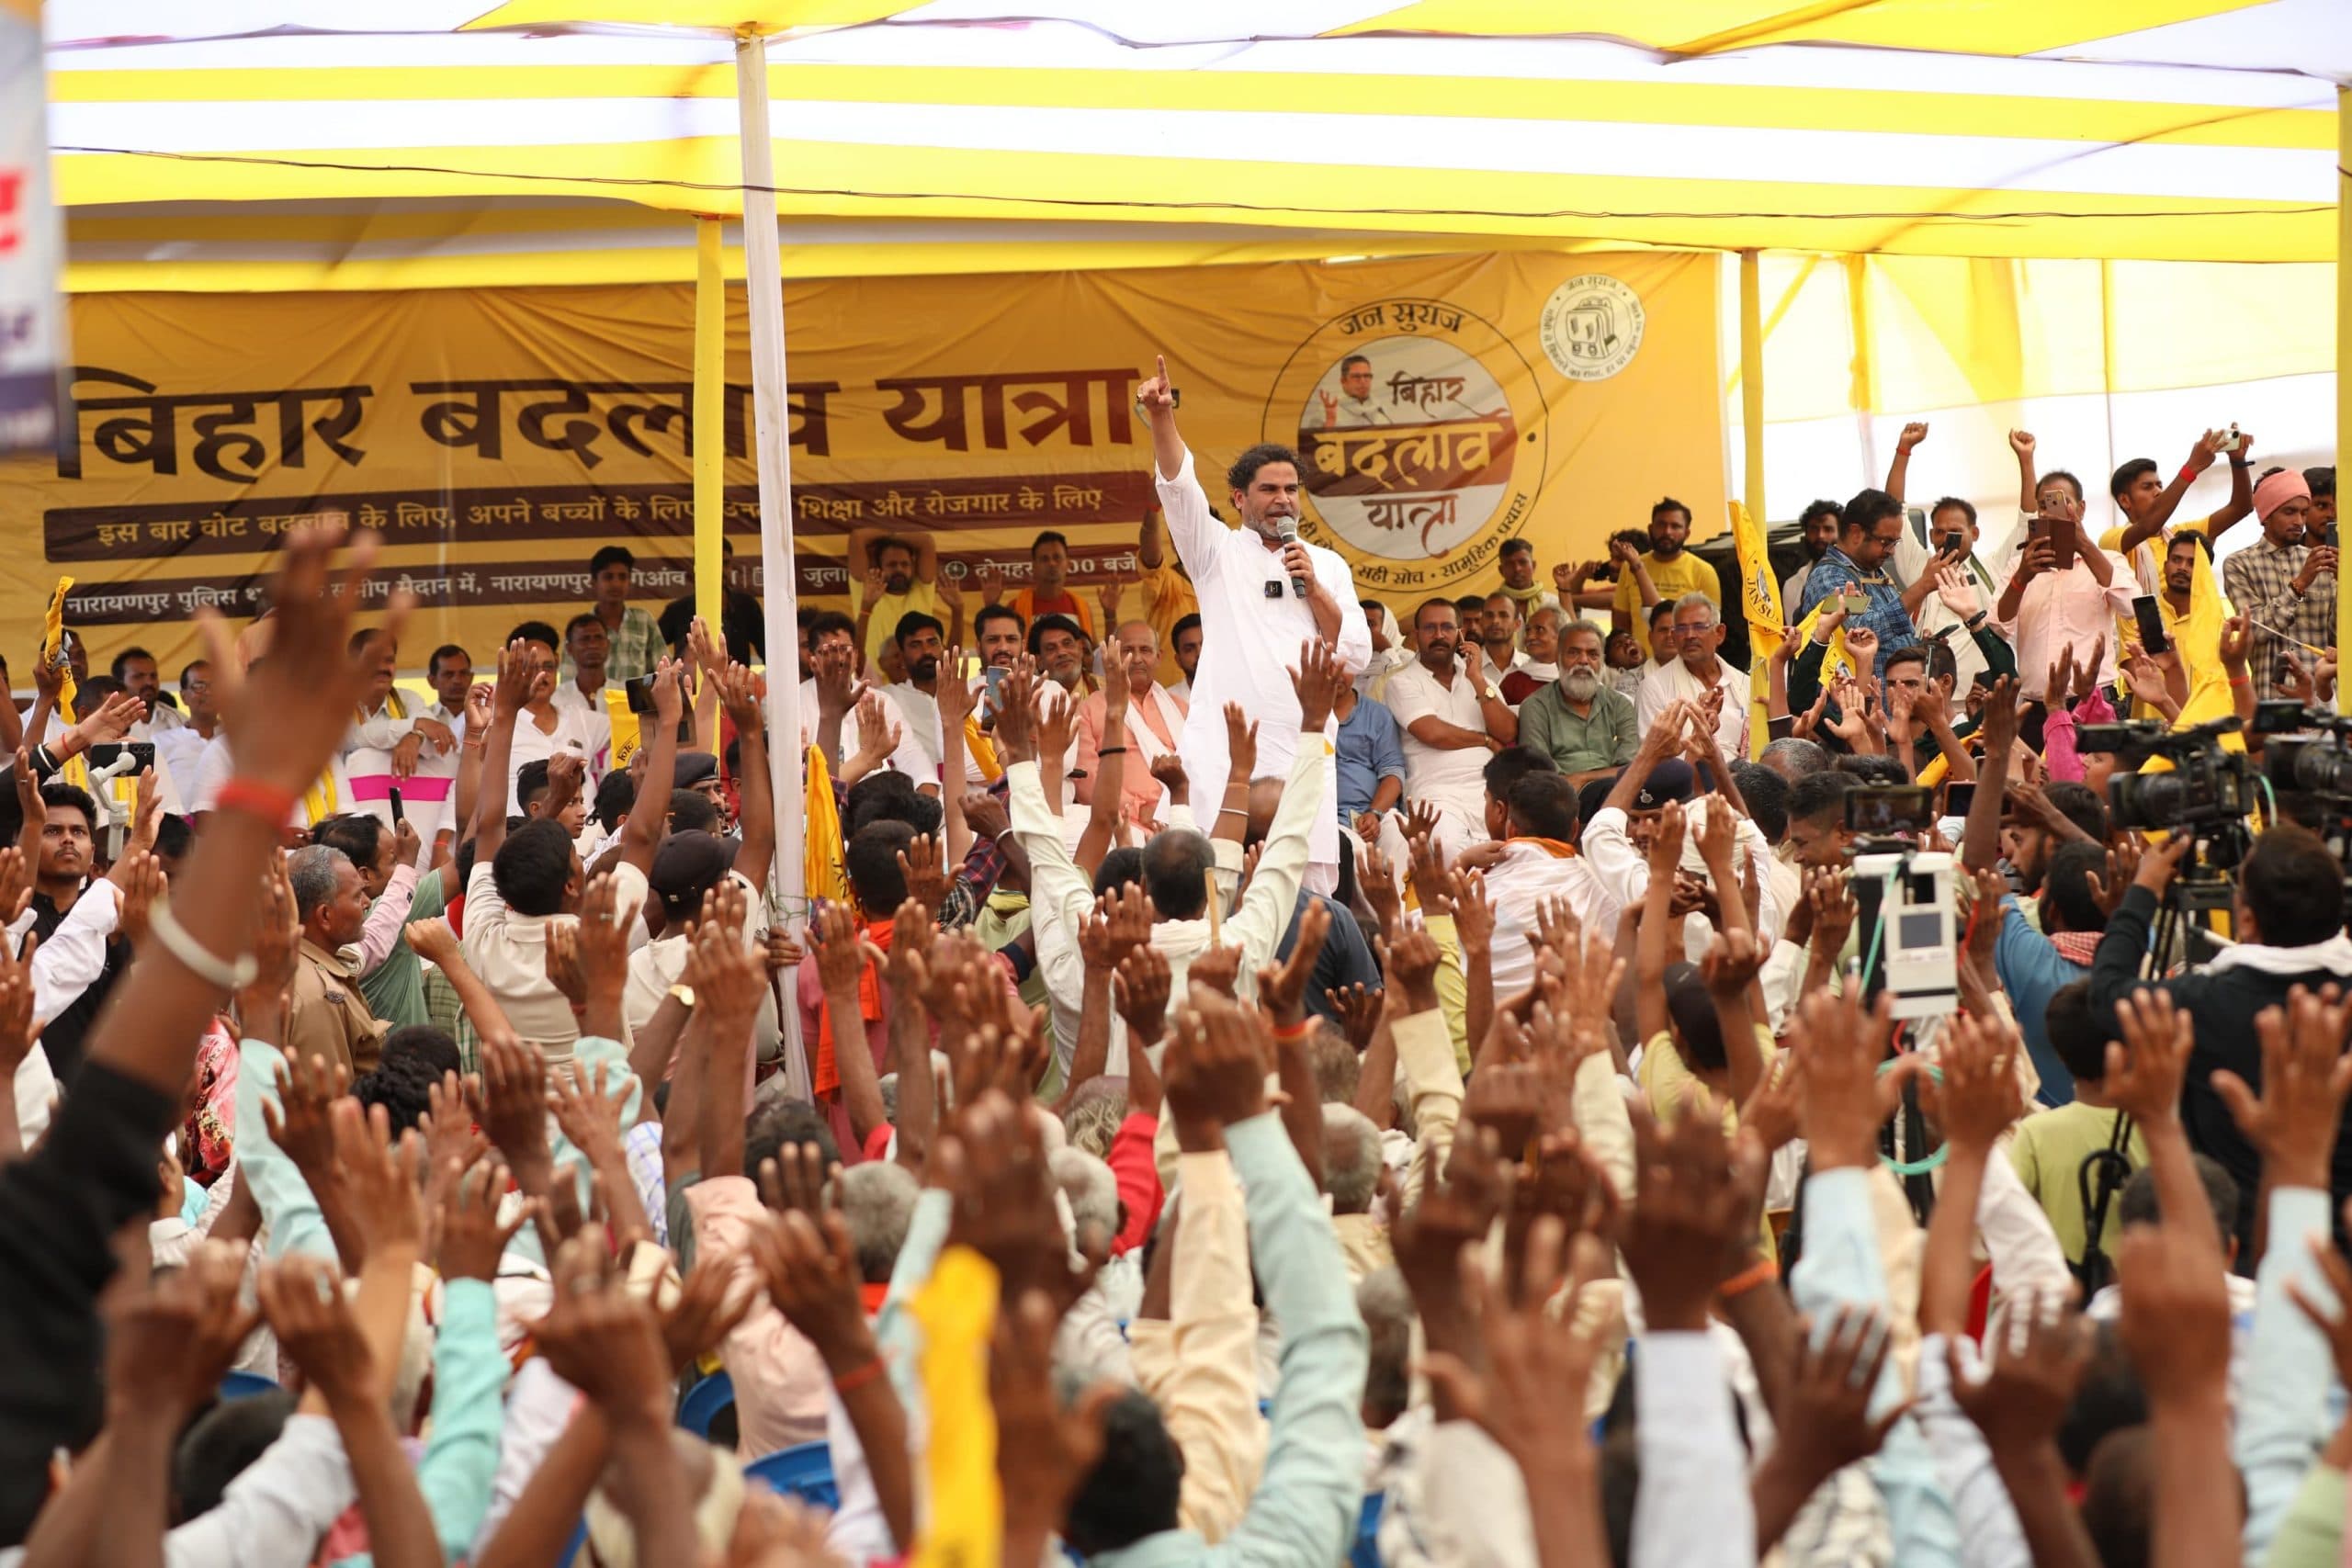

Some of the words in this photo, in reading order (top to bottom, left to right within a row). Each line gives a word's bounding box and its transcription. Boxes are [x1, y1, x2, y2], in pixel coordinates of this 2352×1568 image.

[1337, 306, 1384, 334] जन
[1391, 303, 1465, 333] सुराज
[58, 366, 374, 484] बिहार
[410, 378, 841, 470] बदलाव
[875, 368, 1141, 452] यात्रा
[1385, 370, 1466, 419] बिहार
[1314, 422, 1504, 491] बदलाव
[96, 522, 139, 547] इस
[149, 520, 191, 541] बार
[198, 512, 249, 537] वोट
[256, 511, 350, 535] बदलाव
[359, 504, 388, 530] के
[397, 502, 457, 528] लिए,
[468, 497, 532, 525] अपने
[540, 494, 607, 522] बच्चों
[612, 496, 641, 520] के
[797, 494, 865, 522] शिक्षा
[872, 490, 917, 517] और
[924, 489, 1011, 515] रोजगार
[1019, 484, 1045, 512] के
[1054, 485, 1103, 511] लिए
[1361, 493, 1460, 558] यात्रा
[66, 592, 170, 615] नारायणपुर
[177, 586, 237, 613] पुलिस
[491, 572, 593, 595] नारायणपुर
[802, 566, 849, 588] जुला
[1102, 551, 1137, 571] बजे
[1357, 561, 1389, 583] सही
[1393, 569, 1425, 585] सोच
[1441, 536, 1499, 577] सामूहिक
